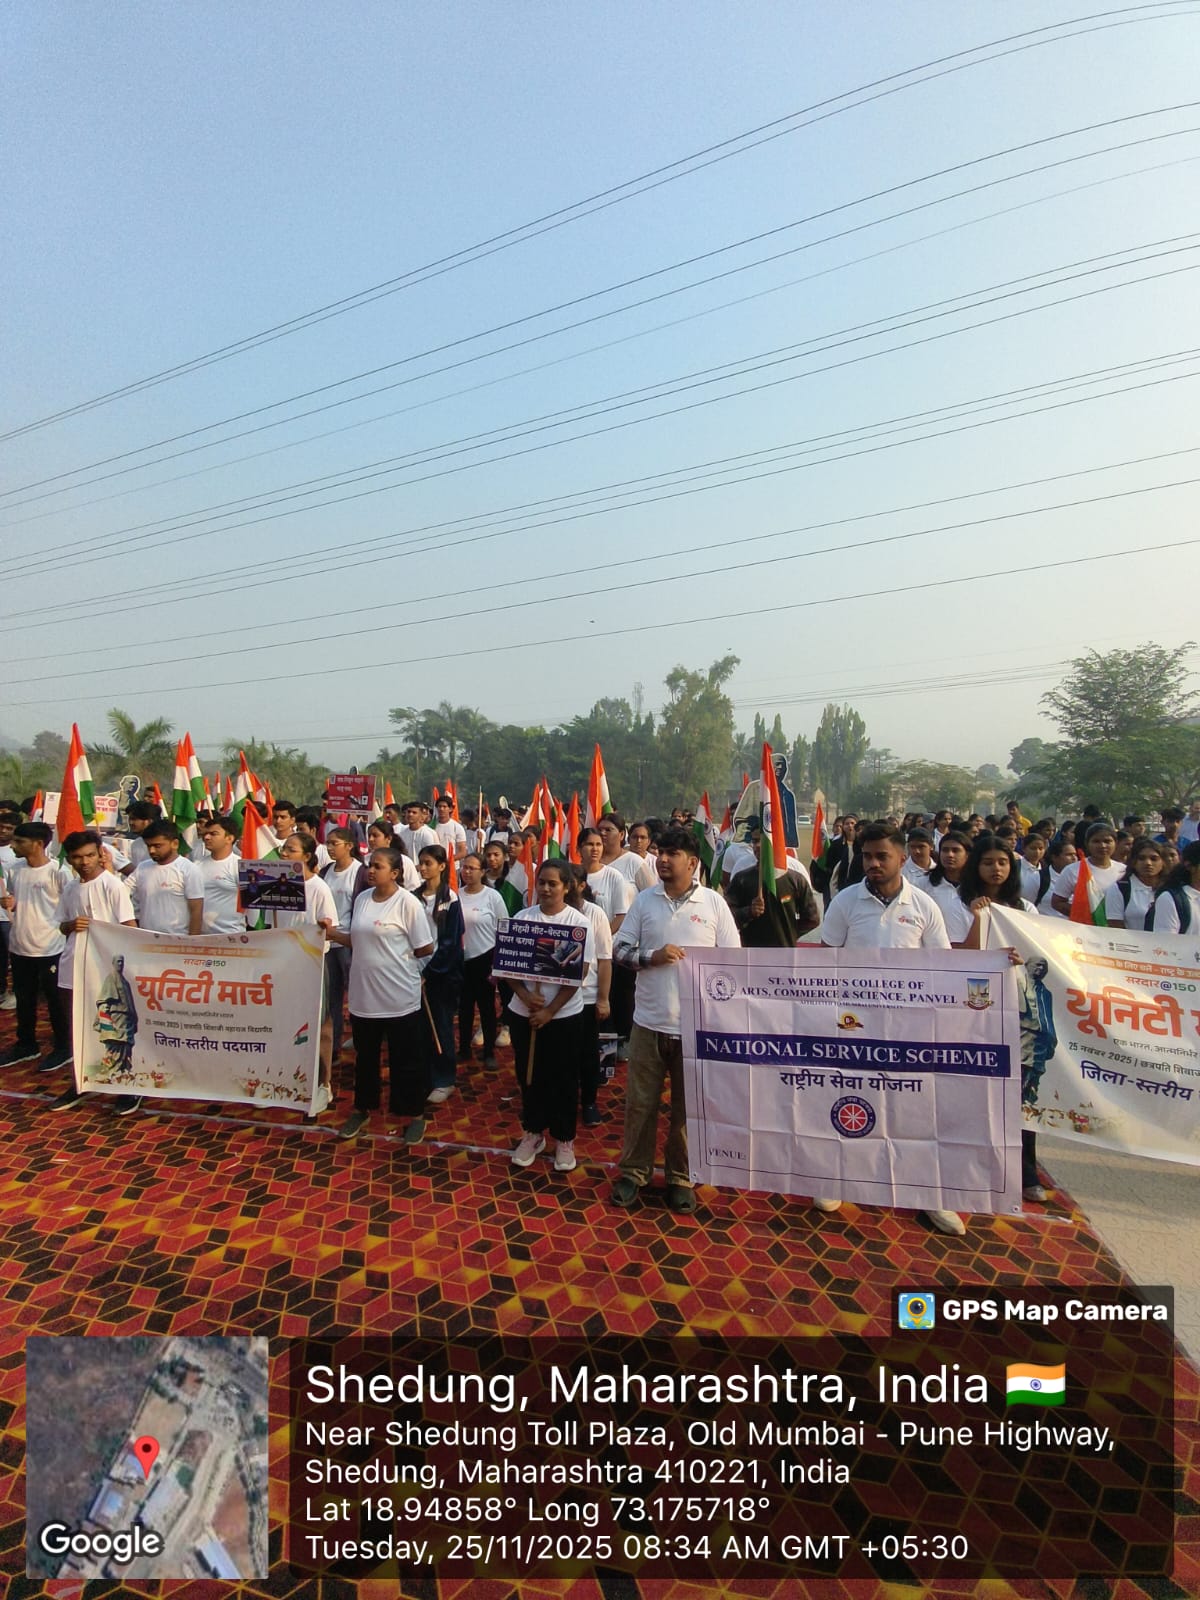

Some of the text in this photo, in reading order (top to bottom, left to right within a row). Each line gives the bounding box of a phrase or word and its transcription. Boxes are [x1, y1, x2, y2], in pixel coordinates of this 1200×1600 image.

[499, 947, 533, 958] Always wear
[504, 960, 516, 968] seat
[135, 969, 273, 1012] यूनिटी मार्च
[767, 976, 925, 990] ST. WILFRED'S COLLEGE OF
[1125, 976, 1197, 992] सरदार@150
[741, 986, 958, 1004] ARTS, COMMERCE & SCIENCE, PANVEL
[1066, 986, 1184, 1039] यूनिटी
[154, 1031, 267, 1054] जिला-स्तरीय पदयात्रा
[705, 1038, 998, 1067] NATIONAL SERVICE SCHEME
[1113, 1038, 1128, 1046] एक
[1068, 1041, 1079, 1051] 25
[1108, 1051, 1132, 1065] 2025
[1140, 1059, 1171, 1073] छत्रपति
[780, 1068, 923, 1092] राष्ट्रीय सेवा योजना
[1080, 1060, 1194, 1101] जिला-स्तरीय
